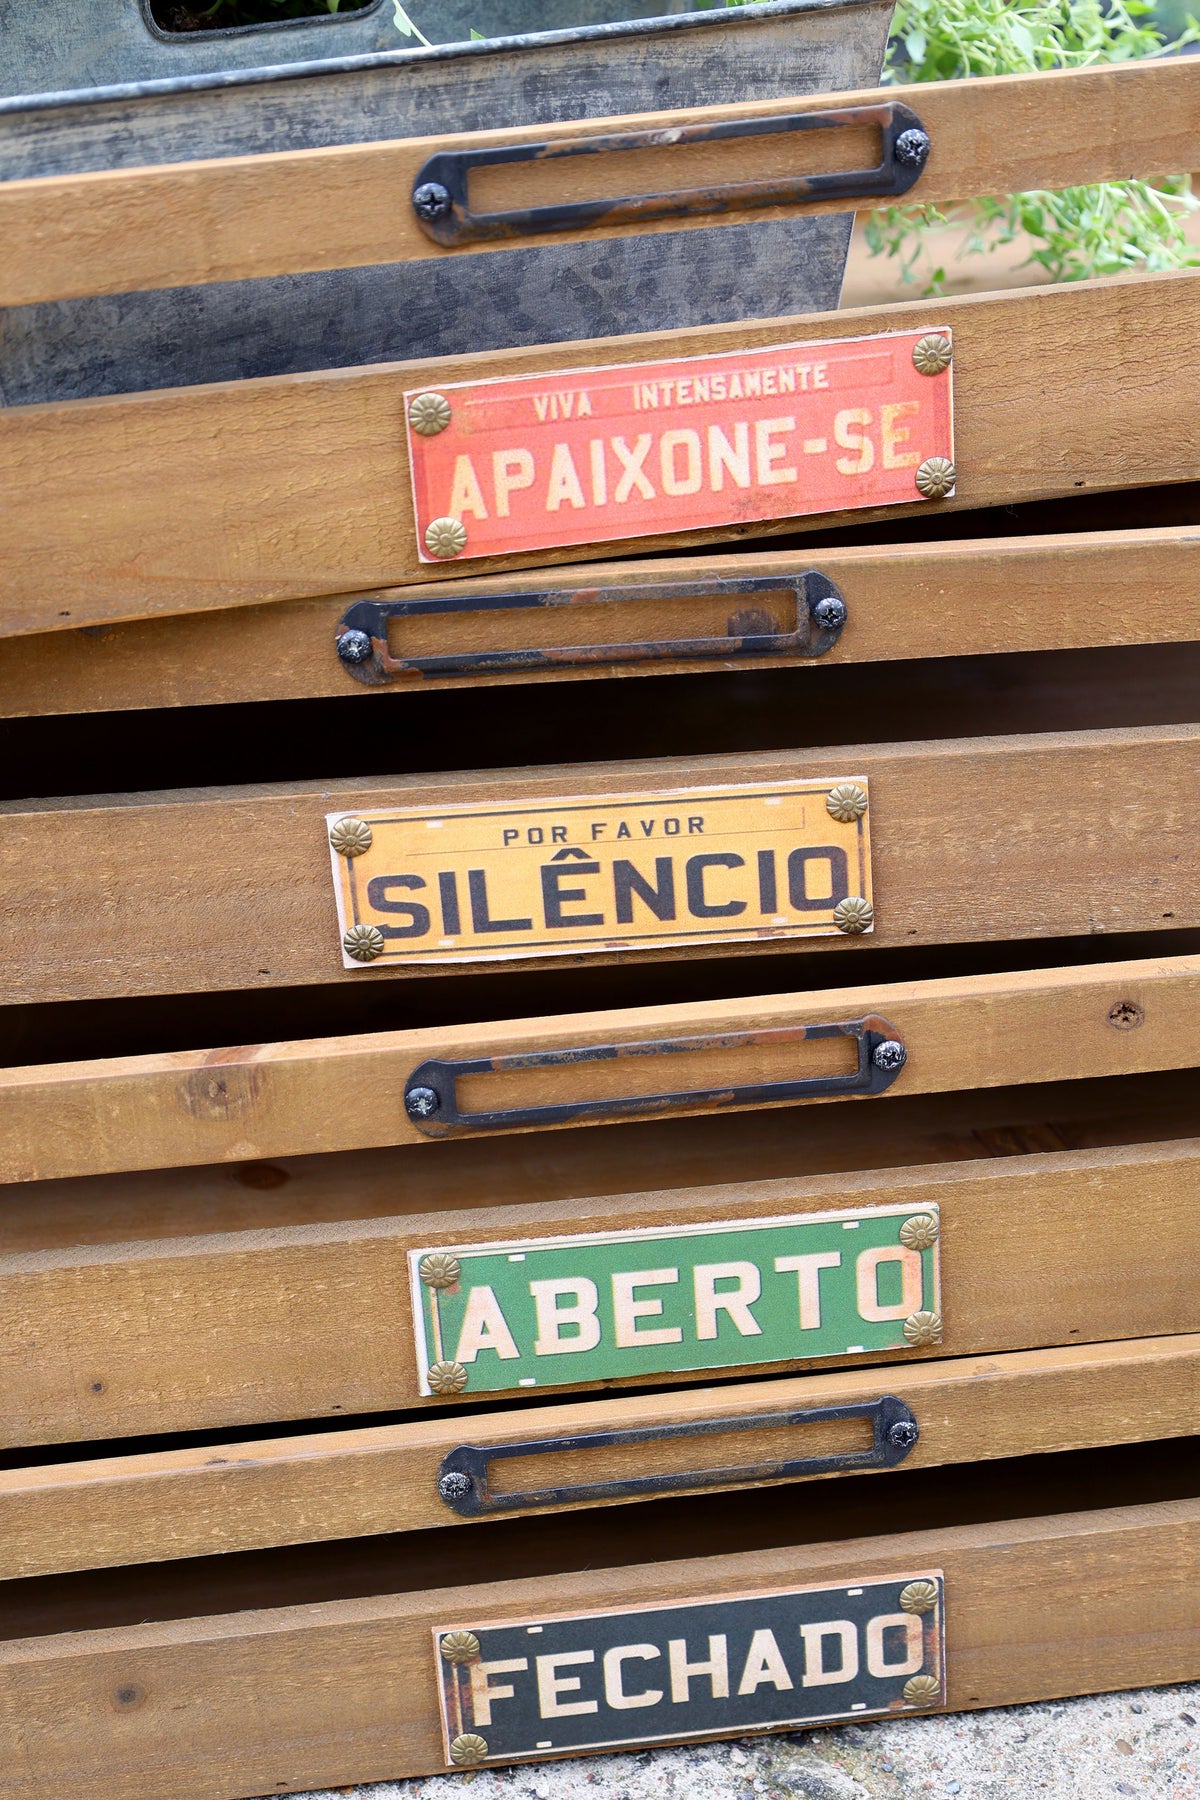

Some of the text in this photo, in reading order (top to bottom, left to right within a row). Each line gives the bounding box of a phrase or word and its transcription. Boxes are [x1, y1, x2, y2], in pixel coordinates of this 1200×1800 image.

[533, 364, 830, 422] VIVA INTENSAMENTE
[449, 401, 922, 521] APAIXONE-SE
[503, 816, 706, 847] POR FAVOR
[367, 845, 849, 940] SILÊNCIO
[454, 1245, 924, 1364] ABERTO
[469, 1612, 924, 1728] FECHADO
